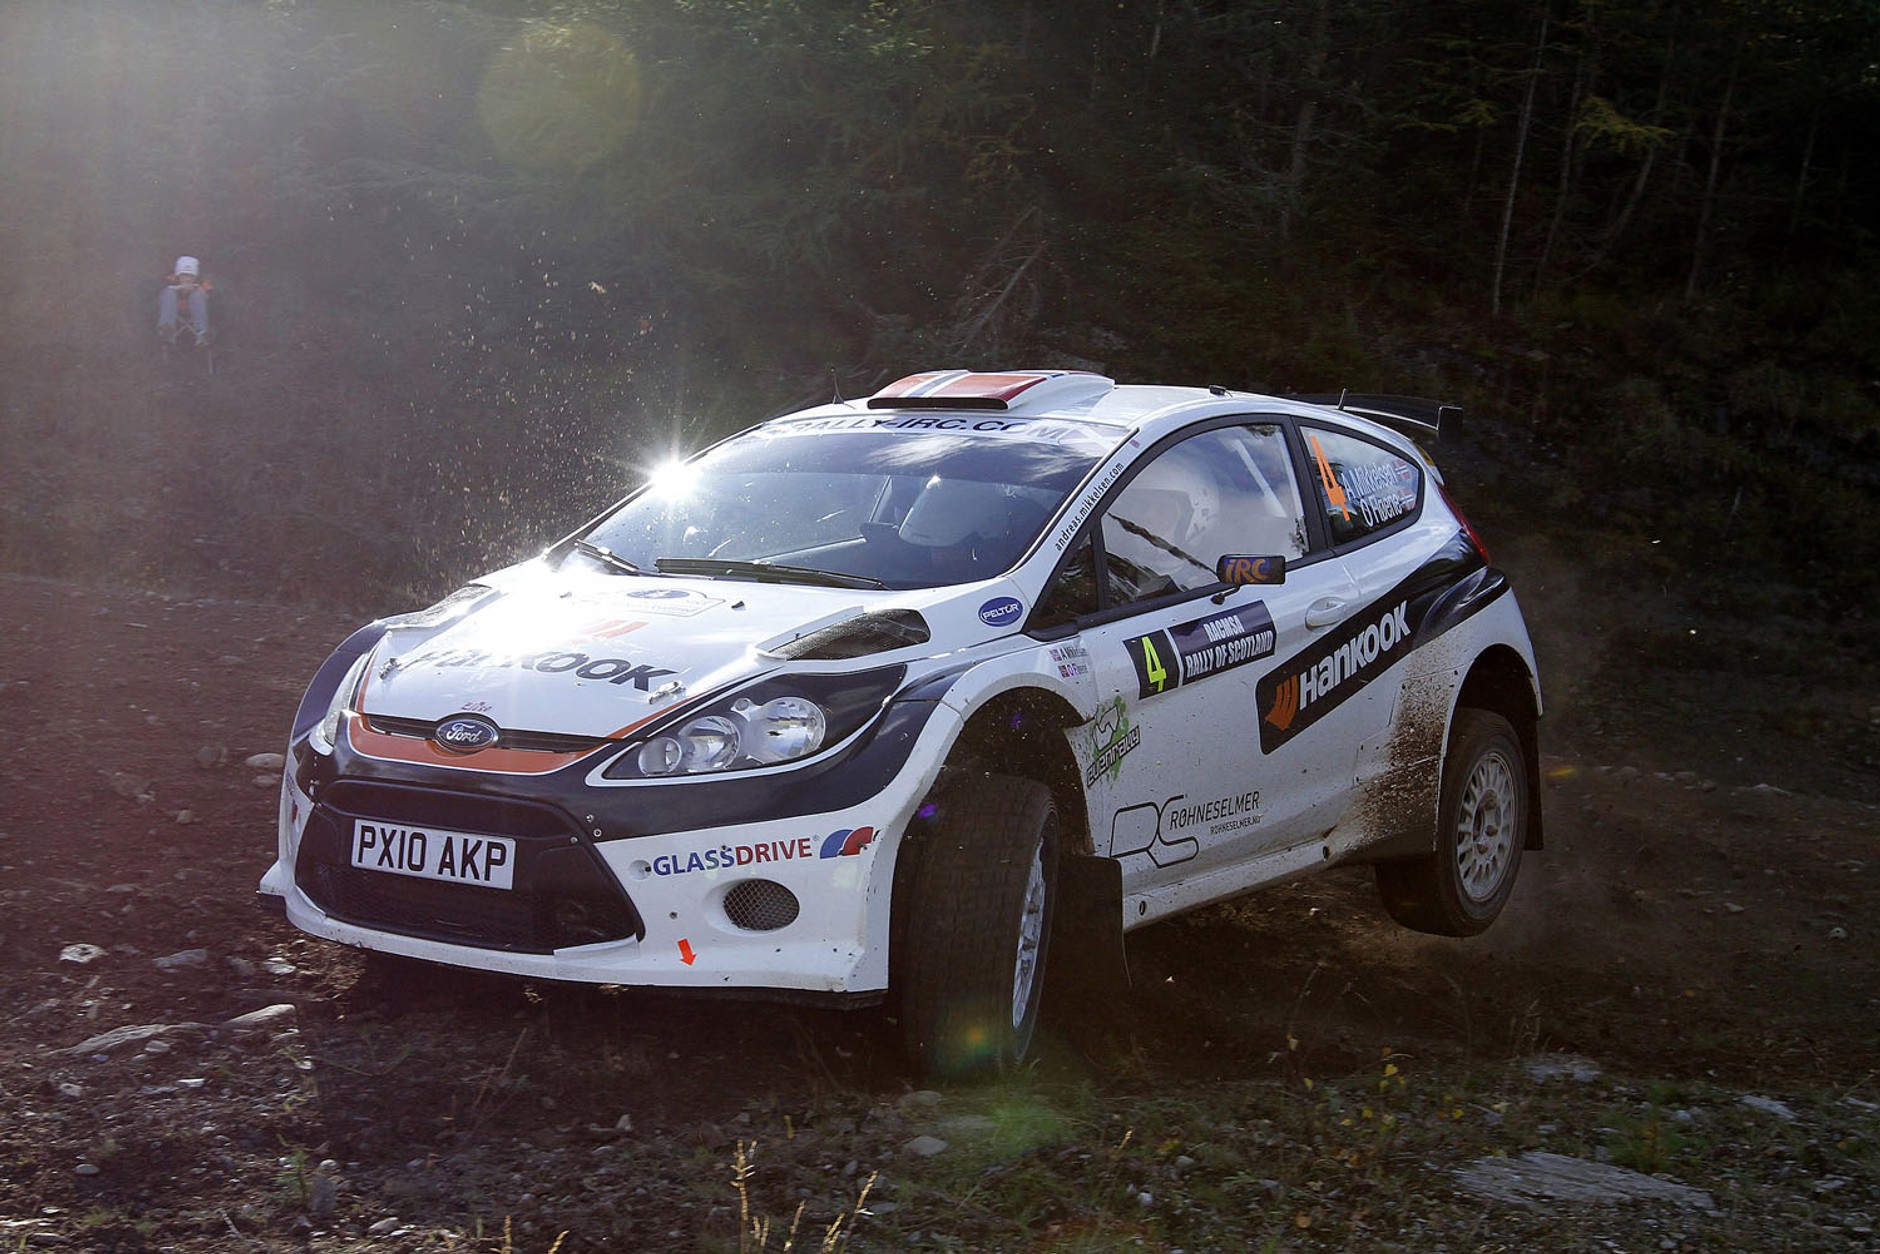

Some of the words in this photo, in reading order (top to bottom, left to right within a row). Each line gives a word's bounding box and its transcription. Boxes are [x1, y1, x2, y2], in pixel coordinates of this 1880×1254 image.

[1309, 435, 1350, 522] 4
[1055, 462, 1124, 552] andreas.mikkelsen.com
[982, 602, 1019, 620] PELTOR
[1203, 614, 1245, 643] RACMSA
[1141, 636, 1168, 692] 4
[1185, 648, 1215, 678] RALLY
[1215, 643, 1229, 669] OF
[1227, 630, 1274, 665] SCOTLAND
[446, 722, 482, 743] Ford
[357, 824, 427, 872] PX10
[438, 836, 507, 882] AKP
[653, 838, 812, 876] GLASSDRIVE
